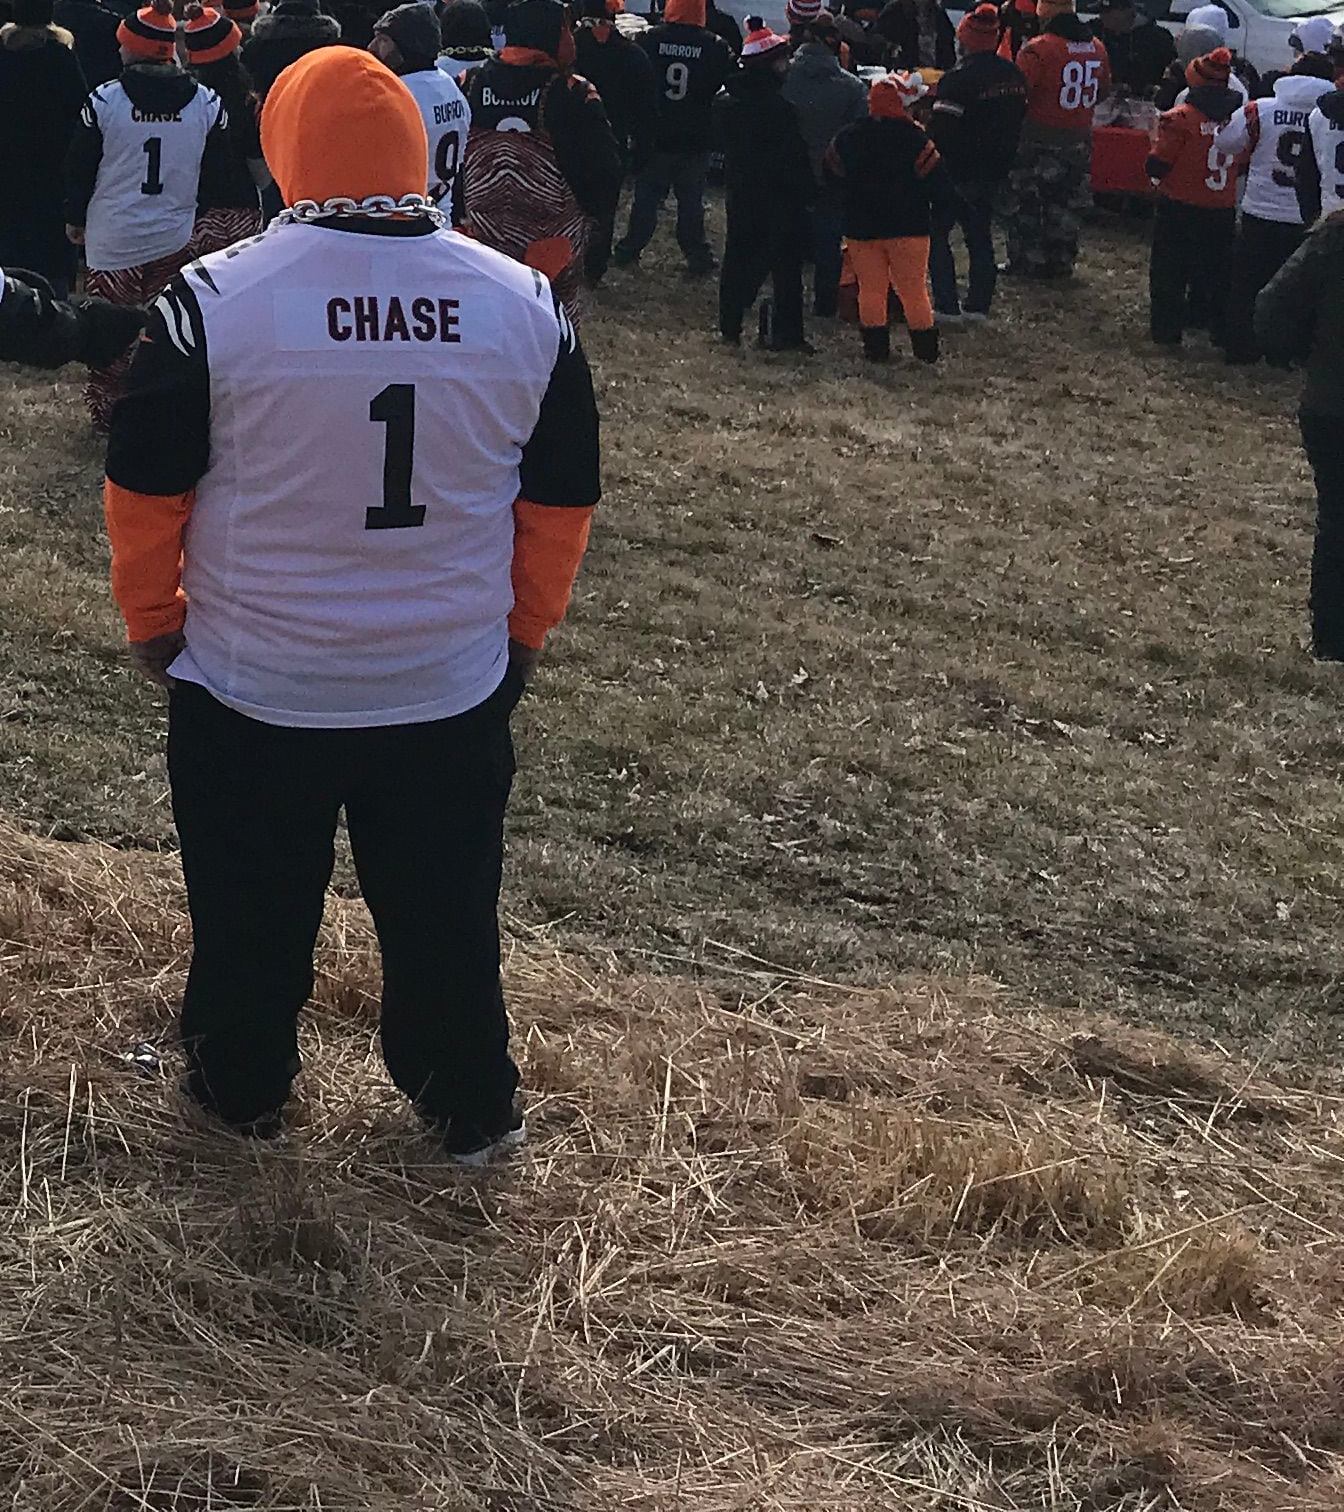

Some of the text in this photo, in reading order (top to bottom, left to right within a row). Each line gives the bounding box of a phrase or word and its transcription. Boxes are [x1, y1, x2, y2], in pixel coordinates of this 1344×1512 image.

[658, 42, 702, 58] BURROW
[665, 62, 689, 101] 9
[1059, 60, 1101, 110] 85
[140, 136, 164, 195] 1
[326, 295, 461, 343] CHASE
[365, 383, 427, 530] 1
